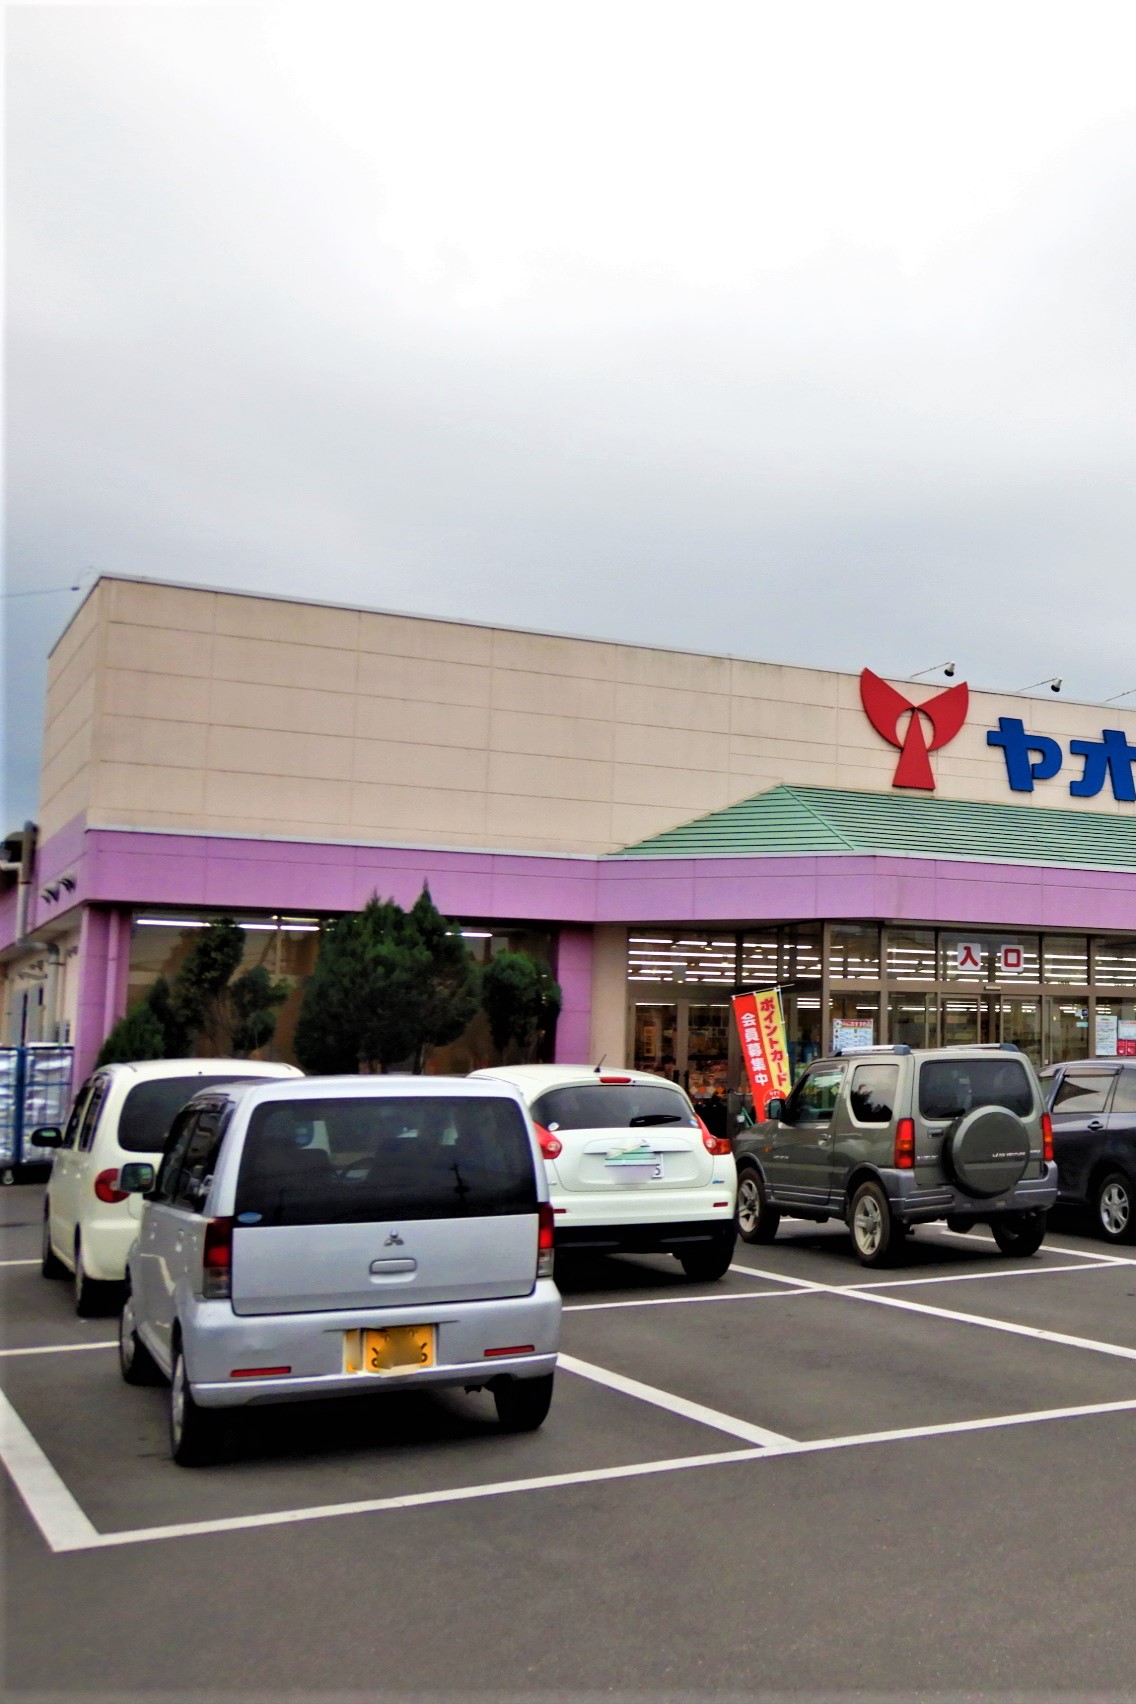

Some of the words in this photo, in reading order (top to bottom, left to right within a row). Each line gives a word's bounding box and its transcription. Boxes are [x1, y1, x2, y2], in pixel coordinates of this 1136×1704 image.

[960, 946, 1021, 967] 入口
[740, 1012, 769, 1087] 会員募集中
[760, 997, 787, 1087] ポイントカード
